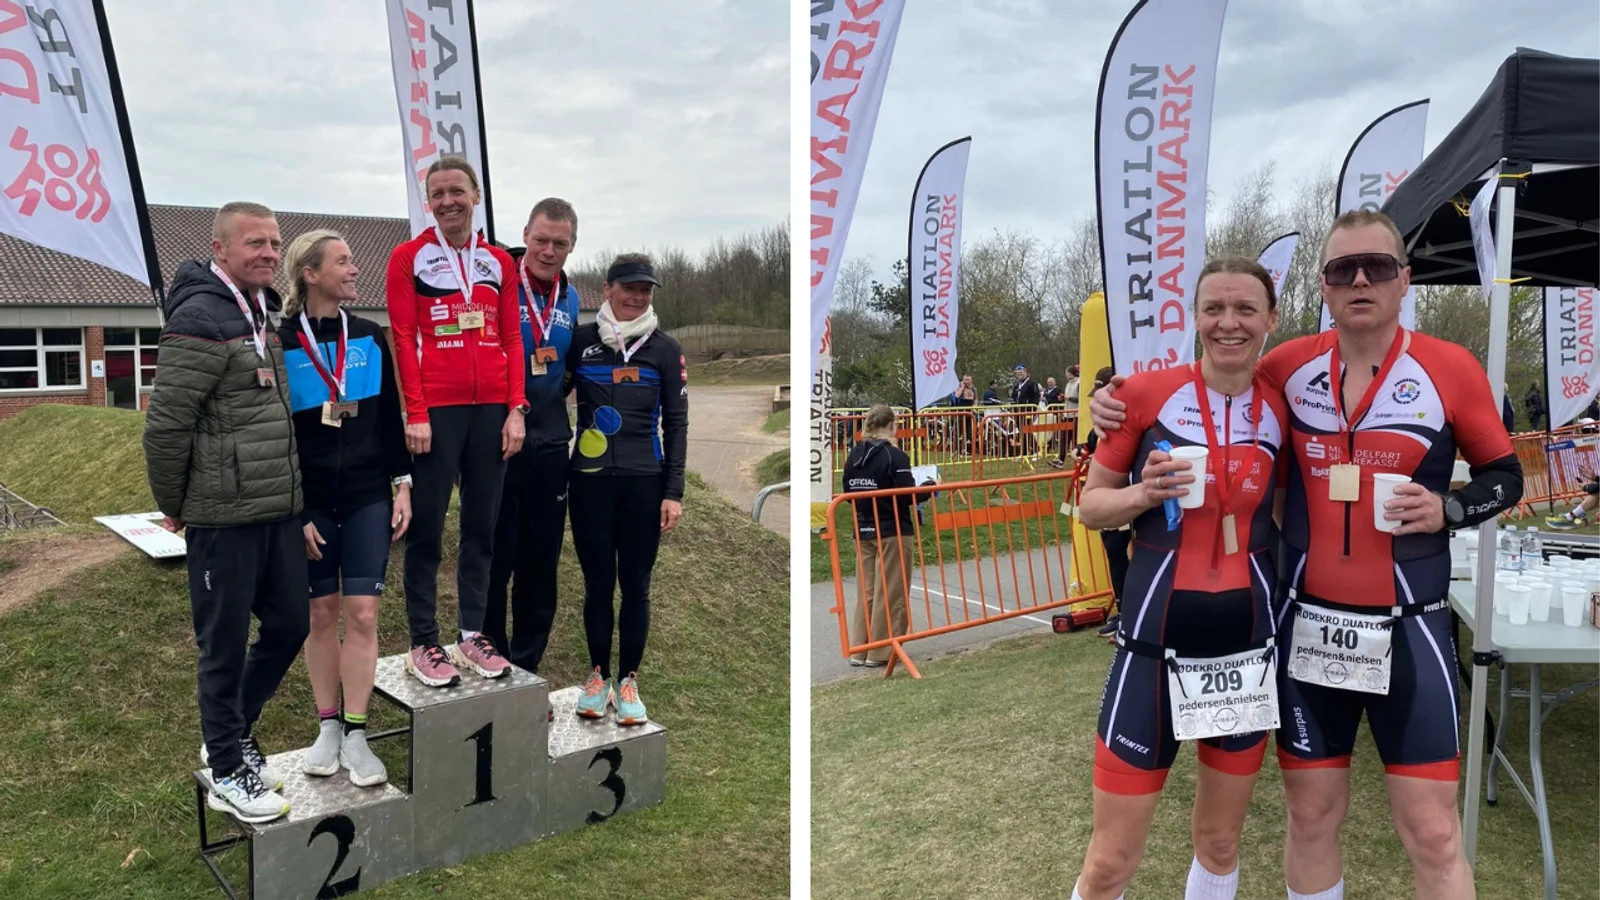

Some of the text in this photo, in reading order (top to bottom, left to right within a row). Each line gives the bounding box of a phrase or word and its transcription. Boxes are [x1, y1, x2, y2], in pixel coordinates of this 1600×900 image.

[1123, 63, 1159, 339] TRIATLON
[1156, 64, 1196, 334] DANMARK
[923, 194, 940, 339] TRIATLON
[936, 193, 957, 339] DANMARK
[849, 479, 878, 487] OFFICIAL
[1297, 646, 1382, 666] pedersen&nielsen
[1320, 625, 1358, 650] 140
[1173, 663, 1221, 674] ØDEKRO
[1200, 670, 1243, 695] 209
[1179, 693, 1269, 713] pedersen&nielsen
[462, 721, 499, 809] 1
[1115, 733, 1150, 755] TRIMTEX
[585, 746, 626, 824] 3
[307, 814, 361, 900] 2
